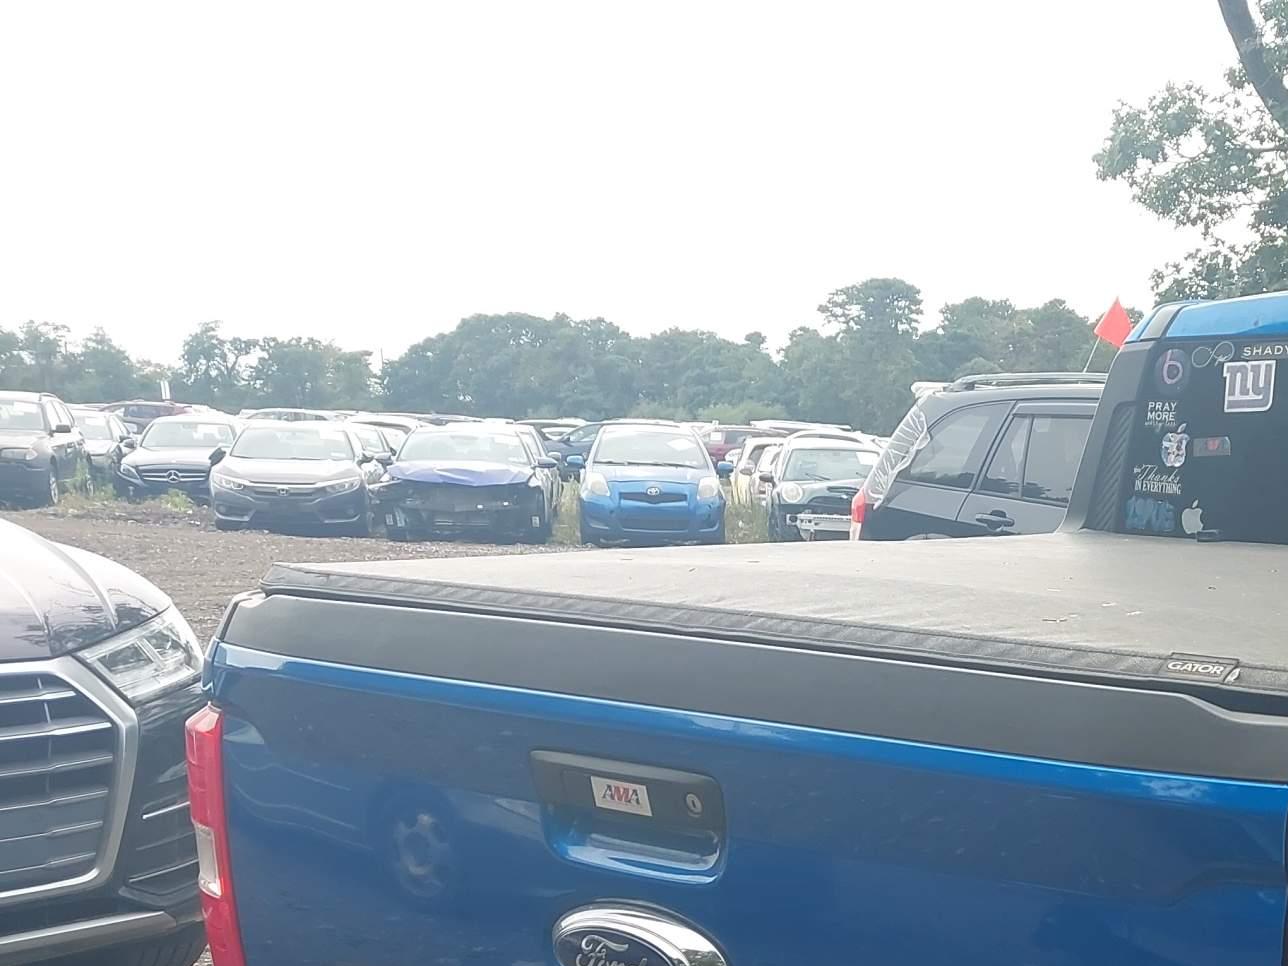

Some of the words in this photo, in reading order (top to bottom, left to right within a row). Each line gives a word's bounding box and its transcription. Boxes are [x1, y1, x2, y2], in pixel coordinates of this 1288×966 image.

[1148, 401, 1177, 411] PRAY
[1147, 411, 1176, 421] MORE
[1137, 464, 1180, 483] Thanks
[1135, 480, 1142, 491] IN
[1142, 481, 1181, 494] EVERYTHING
[1167, 661, 1225, 674] GATOR
